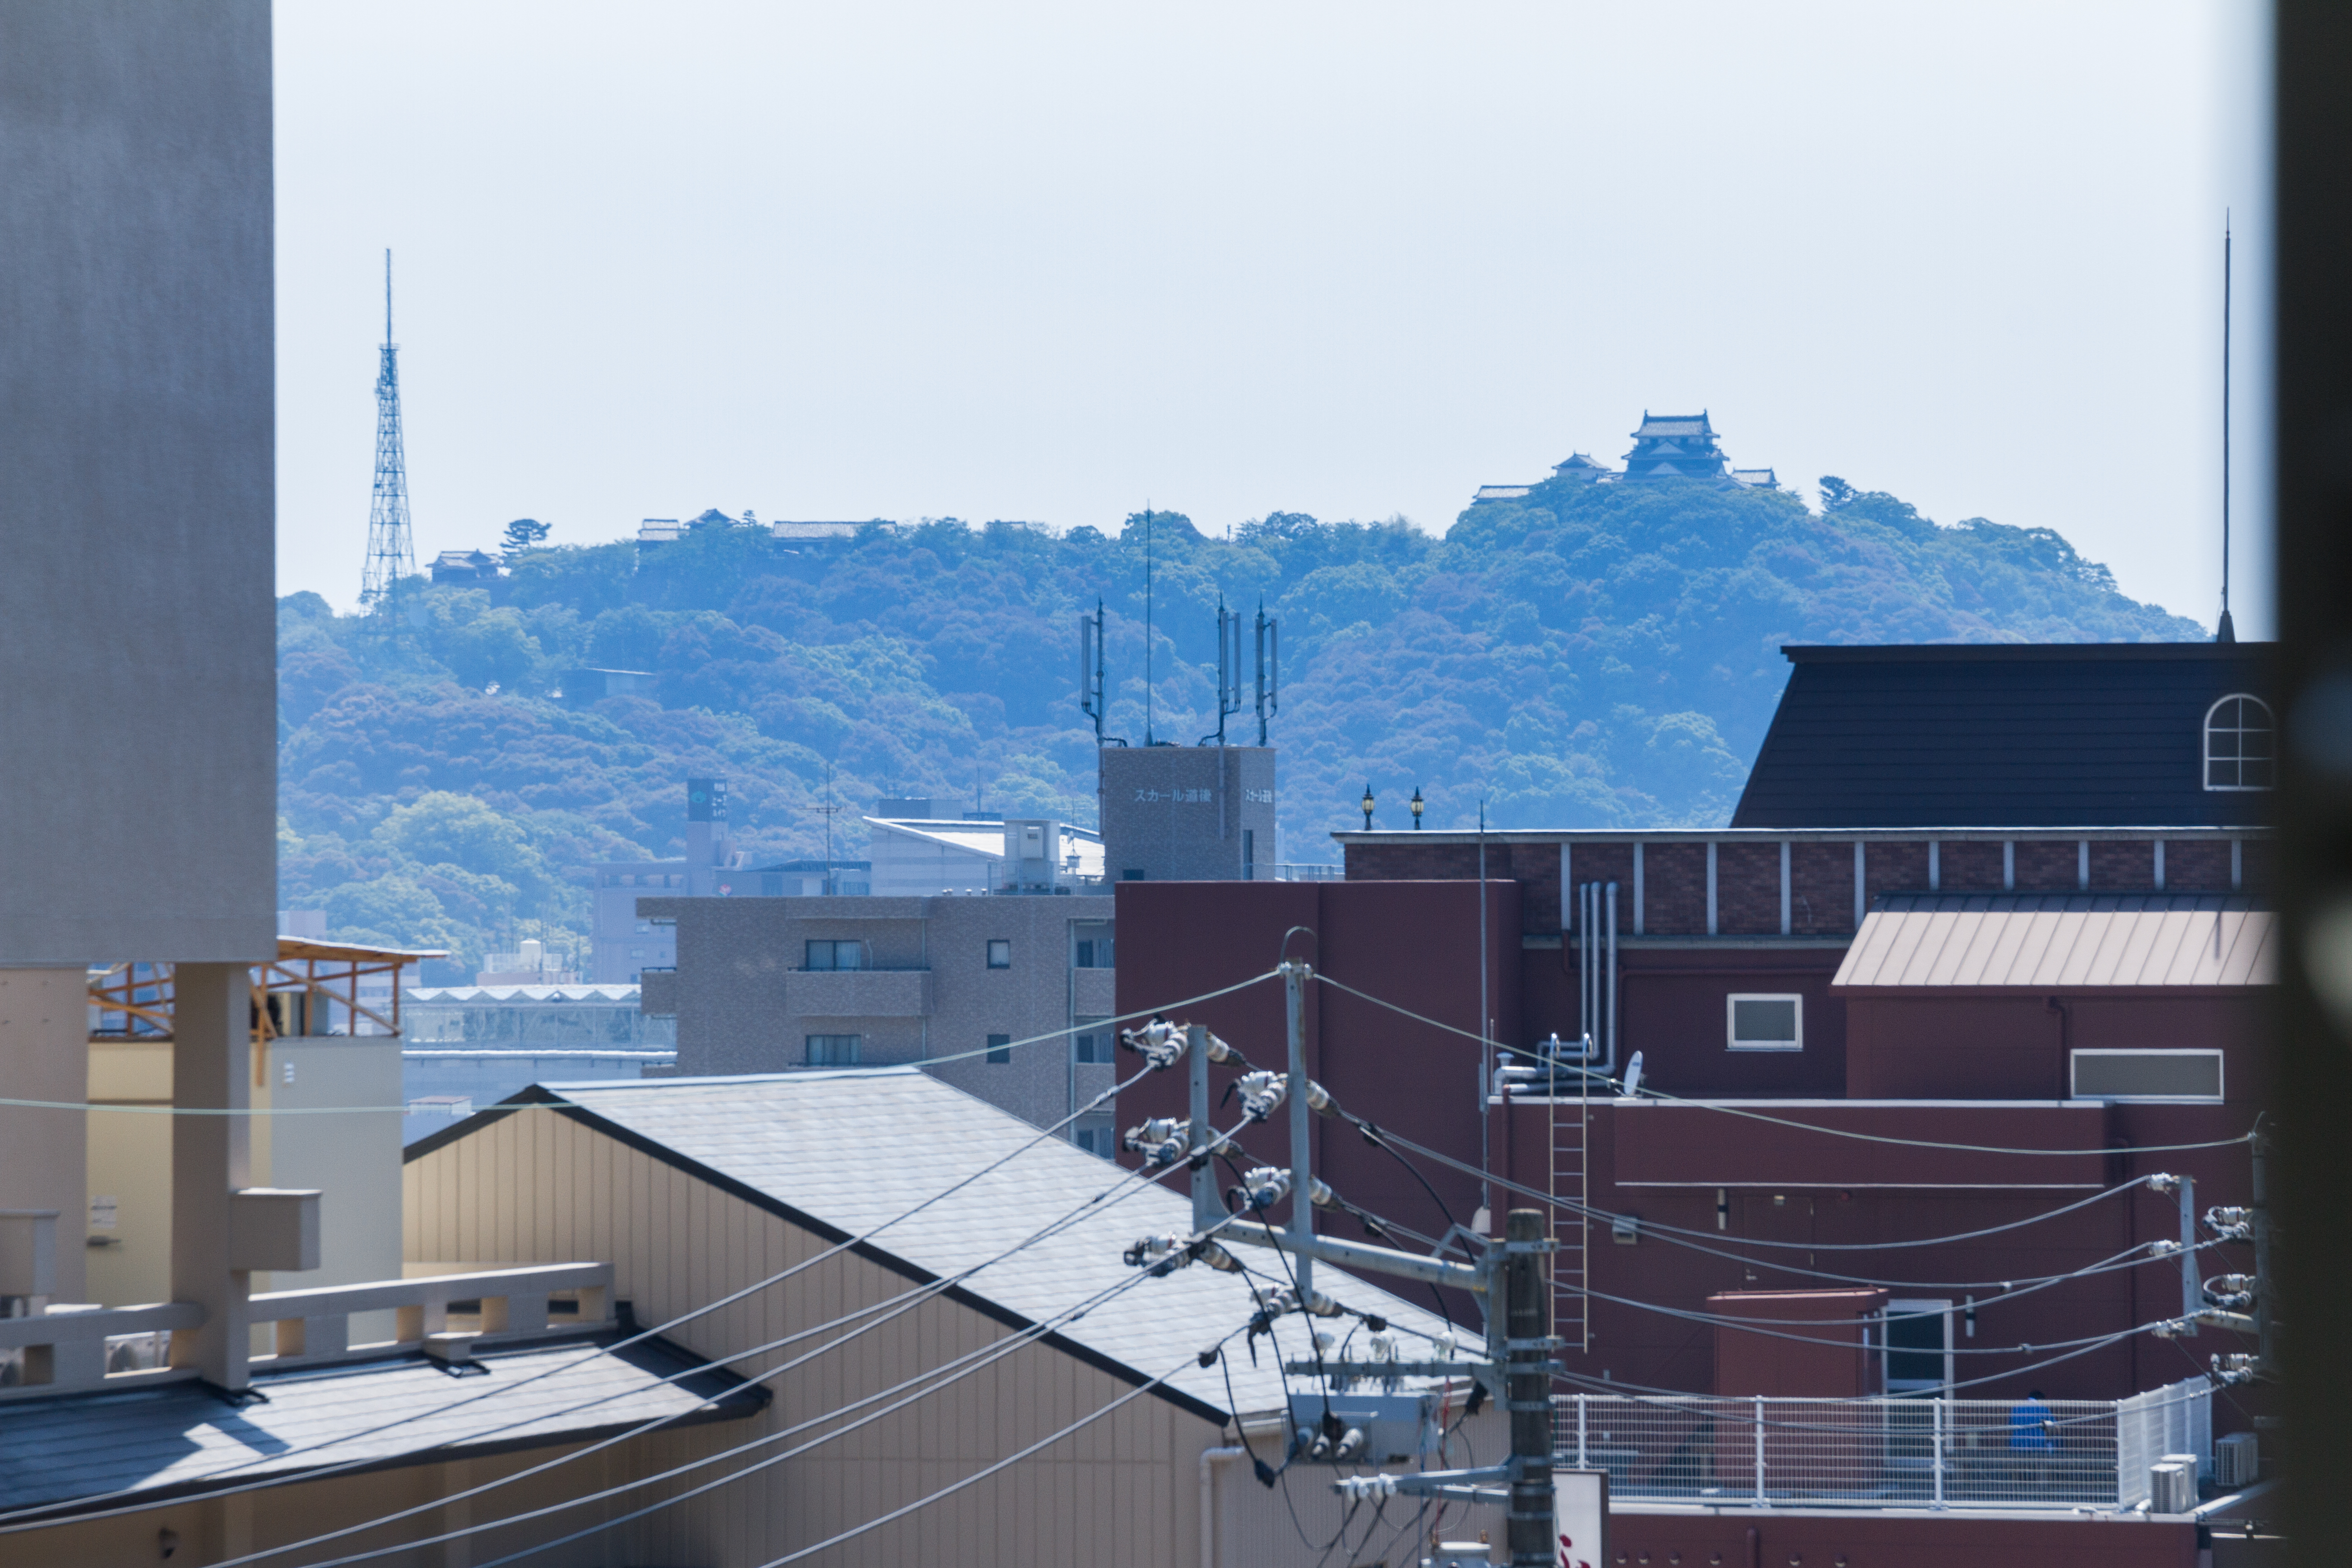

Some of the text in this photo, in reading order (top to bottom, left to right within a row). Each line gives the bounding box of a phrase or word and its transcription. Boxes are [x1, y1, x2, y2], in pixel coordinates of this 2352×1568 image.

[1135, 789, 1212, 803] スカール道後
